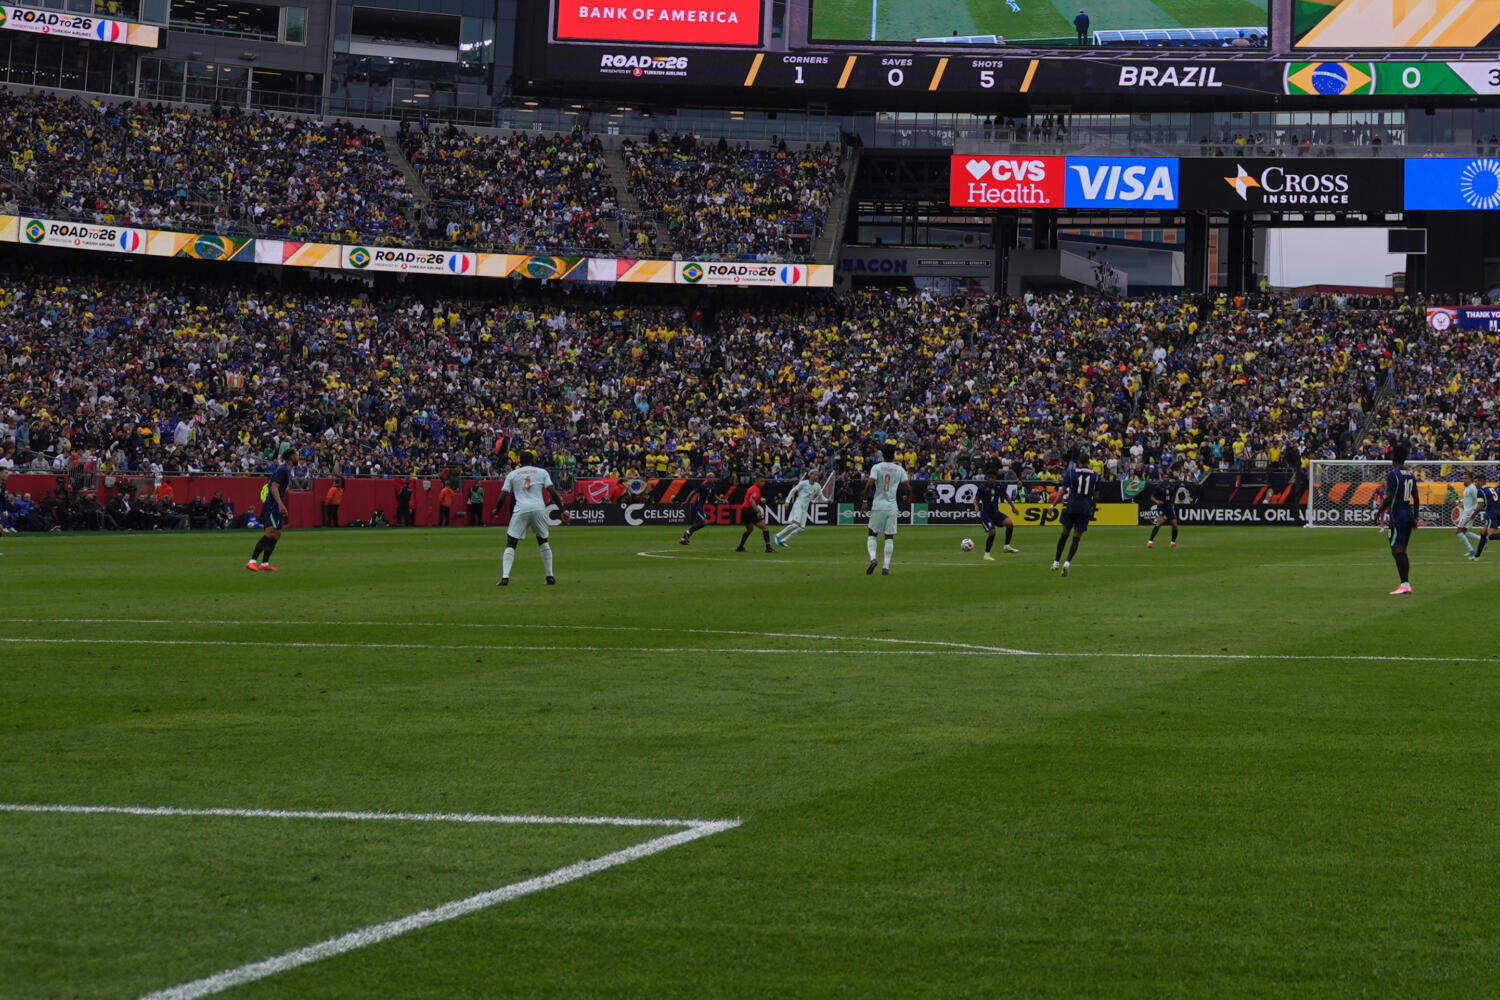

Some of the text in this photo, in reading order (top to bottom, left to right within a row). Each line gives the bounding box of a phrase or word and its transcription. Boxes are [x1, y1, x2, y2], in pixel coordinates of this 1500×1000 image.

[12, 9, 92, 30] ROAD TO 26
[579, 6, 739, 24] BANK OF AMERICA
[600, 54, 688, 70] ROAD TO 26
[783, 55, 829, 65] CORNERS
[882, 58, 913, 66] SAVES
[972, 60, 1003, 69] SHOTS
[795, 66, 804, 85] 1
[887, 69, 904, 87] 0
[980, 71, 995, 88] 5
[1118, 66, 1223, 88] BRAZIL
[1402, 67, 1420, 88] 0
[991, 159, 1046, 181] CVS
[1069, 165, 1174, 201] VISA
[967, 182, 1045, 204] Health
[1263, 194, 1349, 204] INSURANCE
[49, 224, 88, 238] ROAD
[98, 229, 117, 240] 26
[375, 251, 416, 263] ROAD
[426, 253, 445, 264] 26
[837, 258, 907, 273] EACON
[708, 265, 748, 276] ROAD
[758, 266, 777, 276] 26
[1466, 311, 1490, 319] THANK
[1077, 474, 1091, 495] 11
[643, 509, 686, 519] CELSIUS
[1178, 508, 1261, 521] UNIVERSAL
